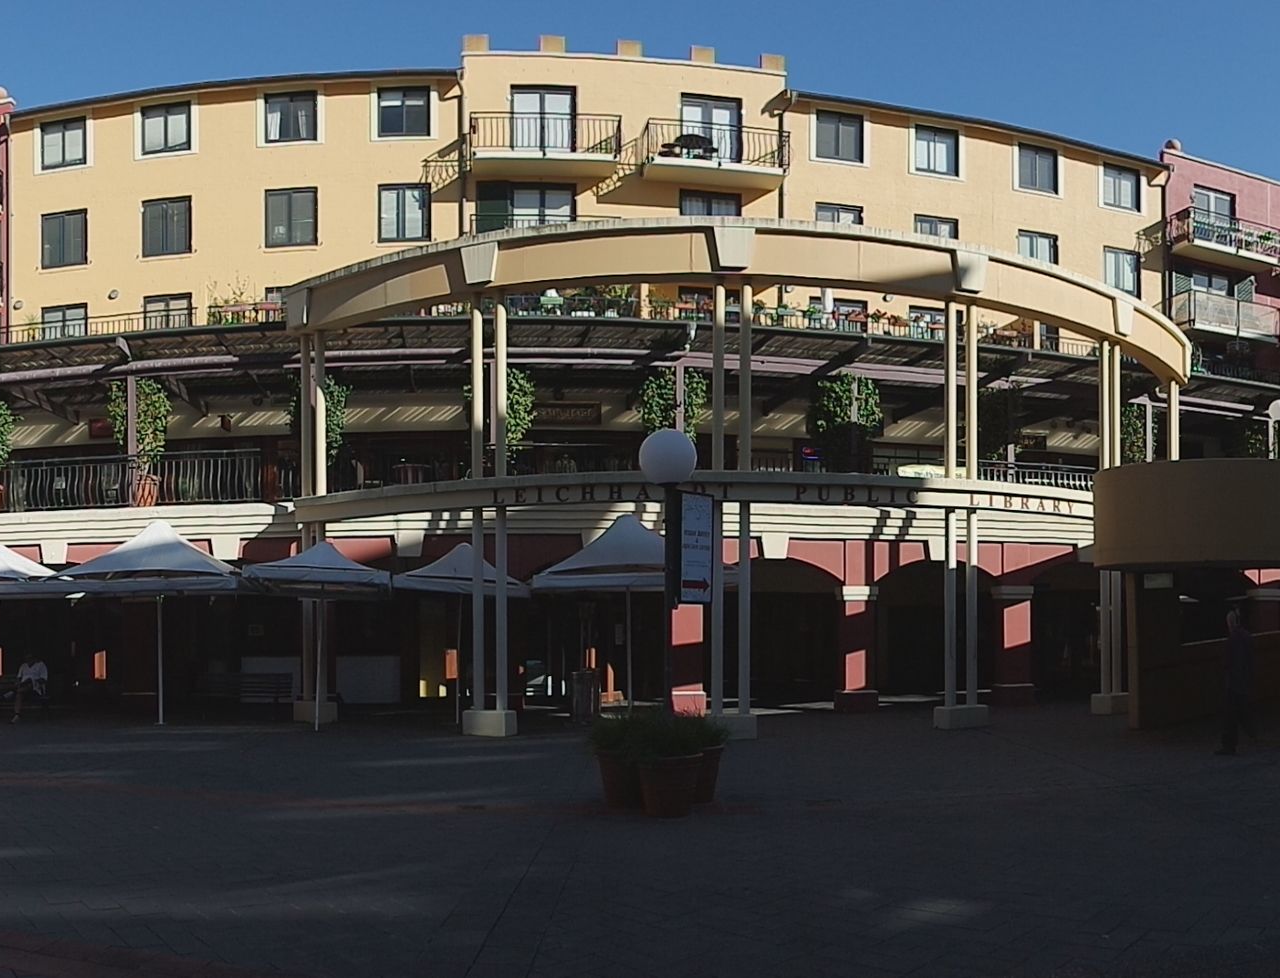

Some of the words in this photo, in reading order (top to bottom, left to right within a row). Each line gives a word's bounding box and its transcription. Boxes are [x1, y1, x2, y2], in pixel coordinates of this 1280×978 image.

[493, 483, 733, 504] LEICHHADT
[794, 485, 919, 504] PUBLIC
[969, 493, 1075, 514] LIBRARY
